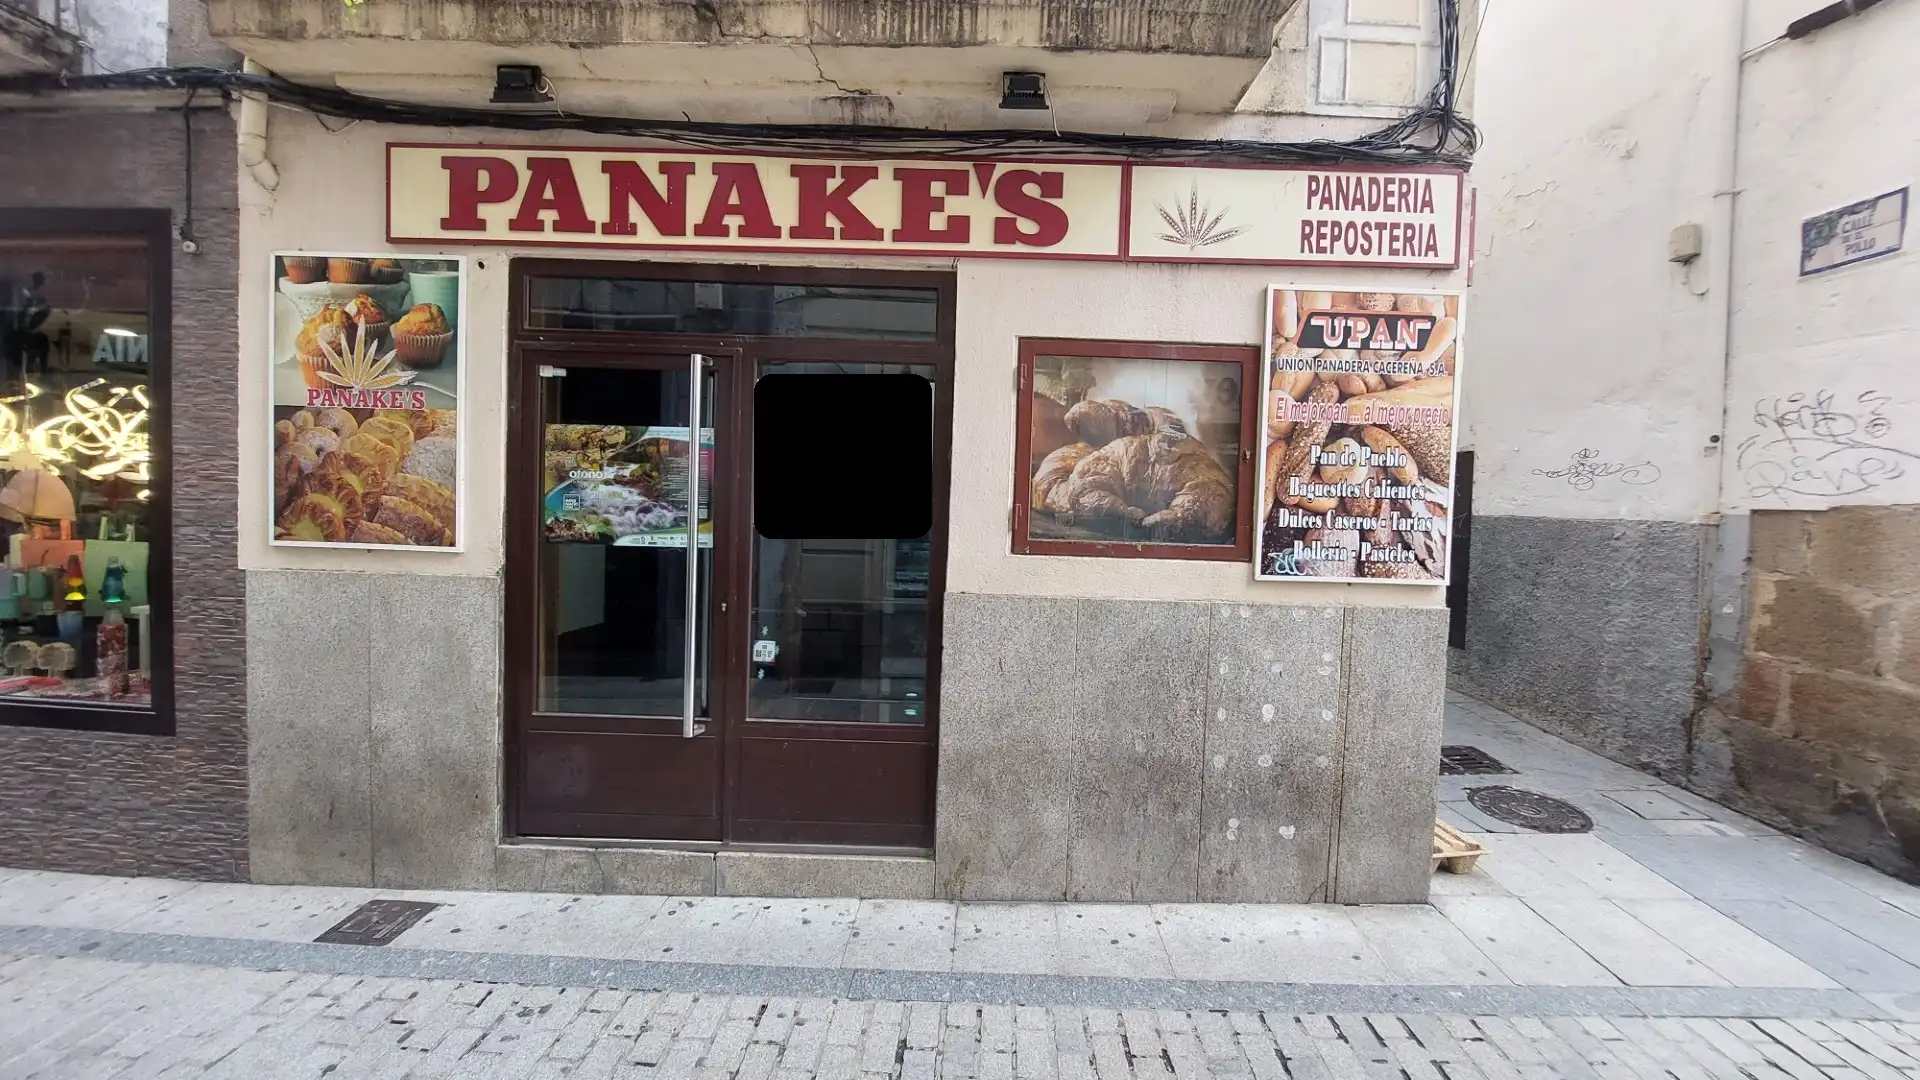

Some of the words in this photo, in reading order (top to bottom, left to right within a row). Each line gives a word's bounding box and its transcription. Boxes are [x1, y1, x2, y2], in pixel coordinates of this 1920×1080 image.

[440, 156, 1070, 247] PANAKE'S
[1307, 174, 1435, 214] PANADERIA
[1300, 219, 1439, 258] REPOSTERIA
[1310, 315, 1432, 350] UPAN
[1316, 359, 1369, 374] PANADERA
[306, 388, 426, 410] PANAKE'S
[1275, 396, 1288, 421] El
[1290, 397, 1326, 428] mejor
[1325, 403, 1348, 427] pan
[1363, 399, 1376, 425] al
[1377, 400, 1413, 431] mejor
[1411, 402, 1450, 429] precio
[1310, 445, 1336, 466] Pan
[1340, 445, 1356, 466] de
[1360, 446, 1408, 468] Pueblo
[1364, 478, 1425, 500] Calientes
[1278, 508, 1323, 529] Dulces
[1325, 508, 1377, 531] Caseros
[1390, 510, 1433, 532] Tartas
[1360, 541, 1416, 563] Pasteles
